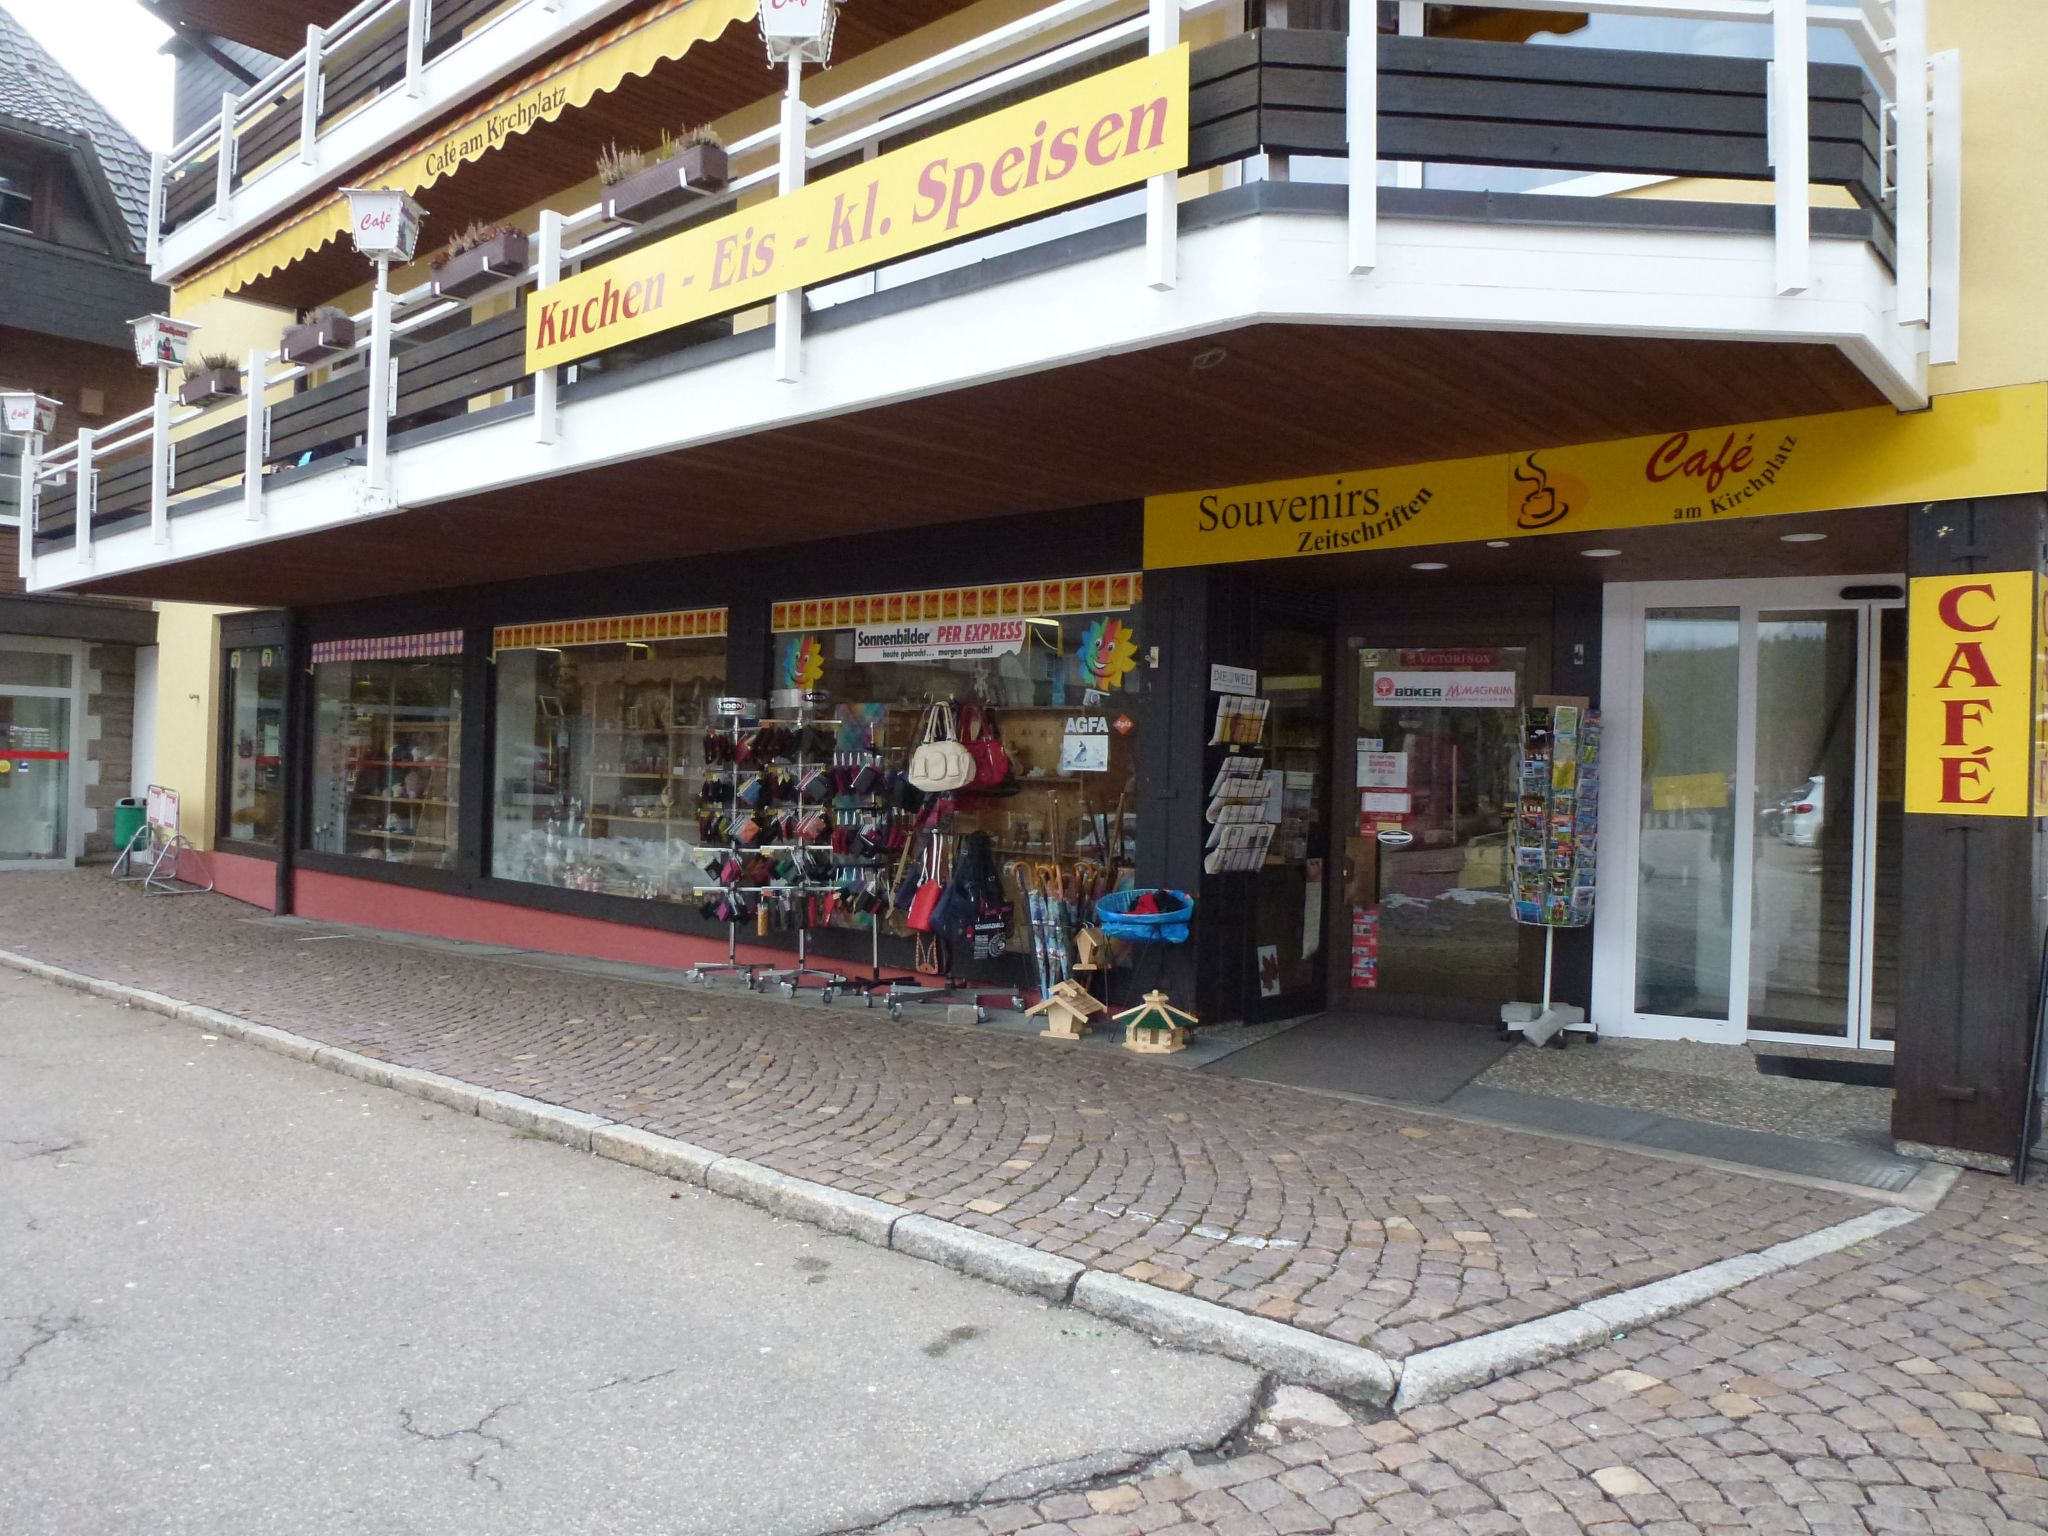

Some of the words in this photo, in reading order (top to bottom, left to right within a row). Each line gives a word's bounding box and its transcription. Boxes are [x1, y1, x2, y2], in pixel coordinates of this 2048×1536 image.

[425, 138, 457, 177] Café
[459, 133, 484, 157] am
[486, 86, 567, 143] Kirchplatz
[535, 271, 666, 350] Kuchen
[708, 226, 777, 292] Eis
[826, 180, 893, 254] kl.
[911, 96, 1169, 232] Speisen
[1645, 431, 1756, 494] Café
[1673, 505, 1703, 520] am
[1709, 434, 1799, 515] Kirchplatz
[1198, 478, 1381, 533] Souvenirs
[1297, 486, 1435, 553] Zeitschriften
[857, 627, 930, 647] Sonnenbilder
[936, 624, 962, 643] PER
[964, 620, 1023, 642] EXPRESS
[882, 648, 900, 658] heute
[937, 649, 963, 658] morgen
[963, 644, 993, 657] gemacht!
[1064, 716, 1109, 733] AGFA
